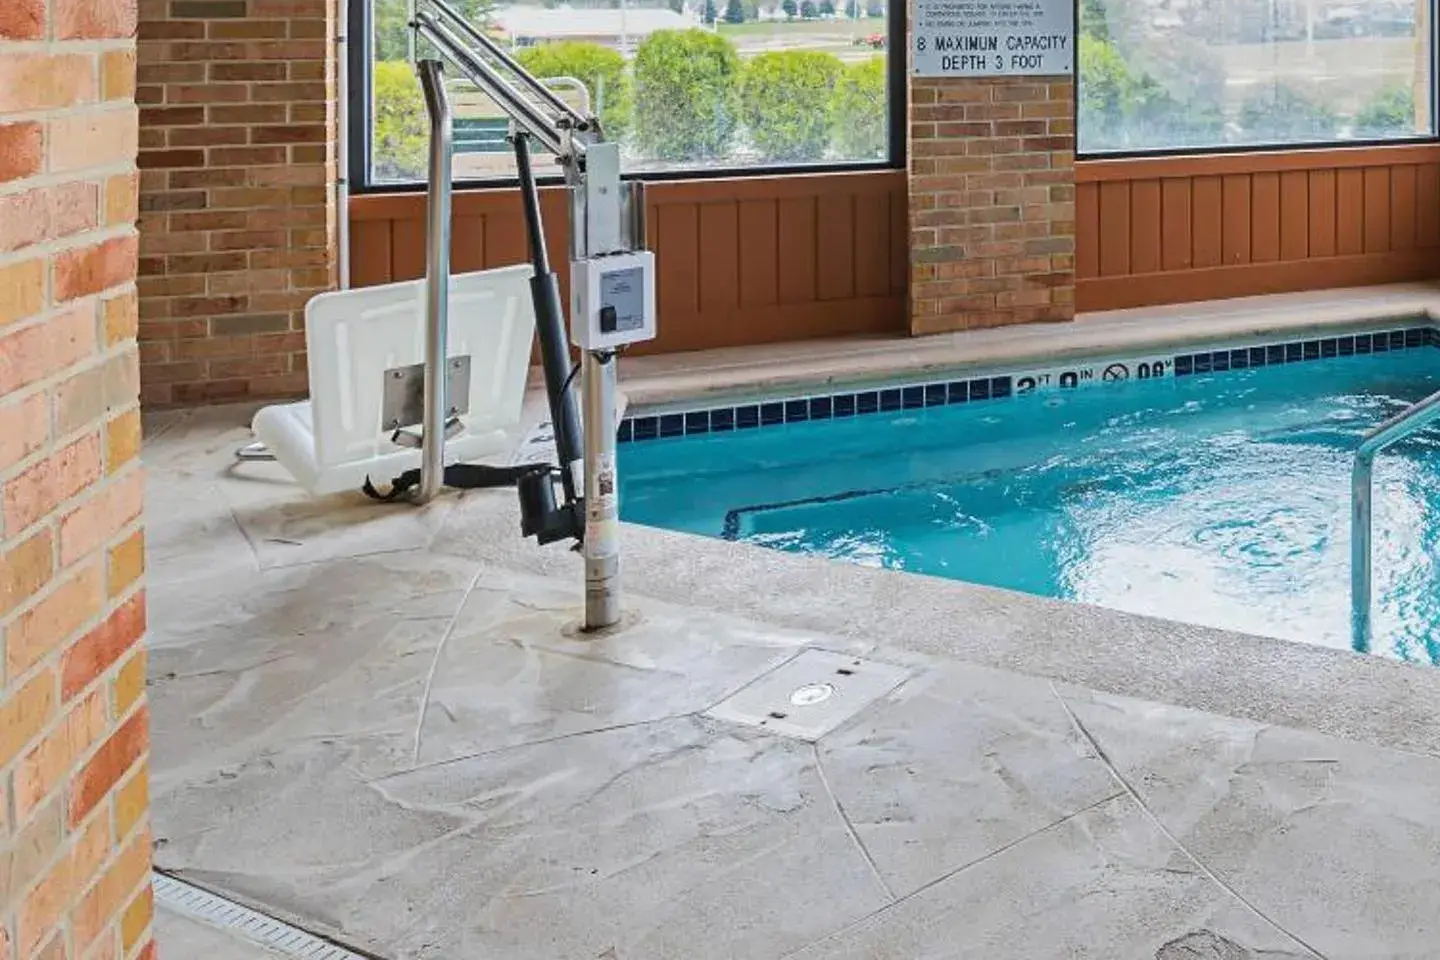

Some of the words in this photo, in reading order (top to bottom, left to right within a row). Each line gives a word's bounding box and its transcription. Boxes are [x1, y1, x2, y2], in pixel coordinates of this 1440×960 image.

[917, 36, 926, 51] 8
[935, 36, 998, 51] MAXIMUM
[1006, 35, 1067, 51] CAPACITY
[942, 55, 986, 71] DEPTH
[995, 55, 1003, 70] 3
[1011, 55, 1045, 70] FOOT
